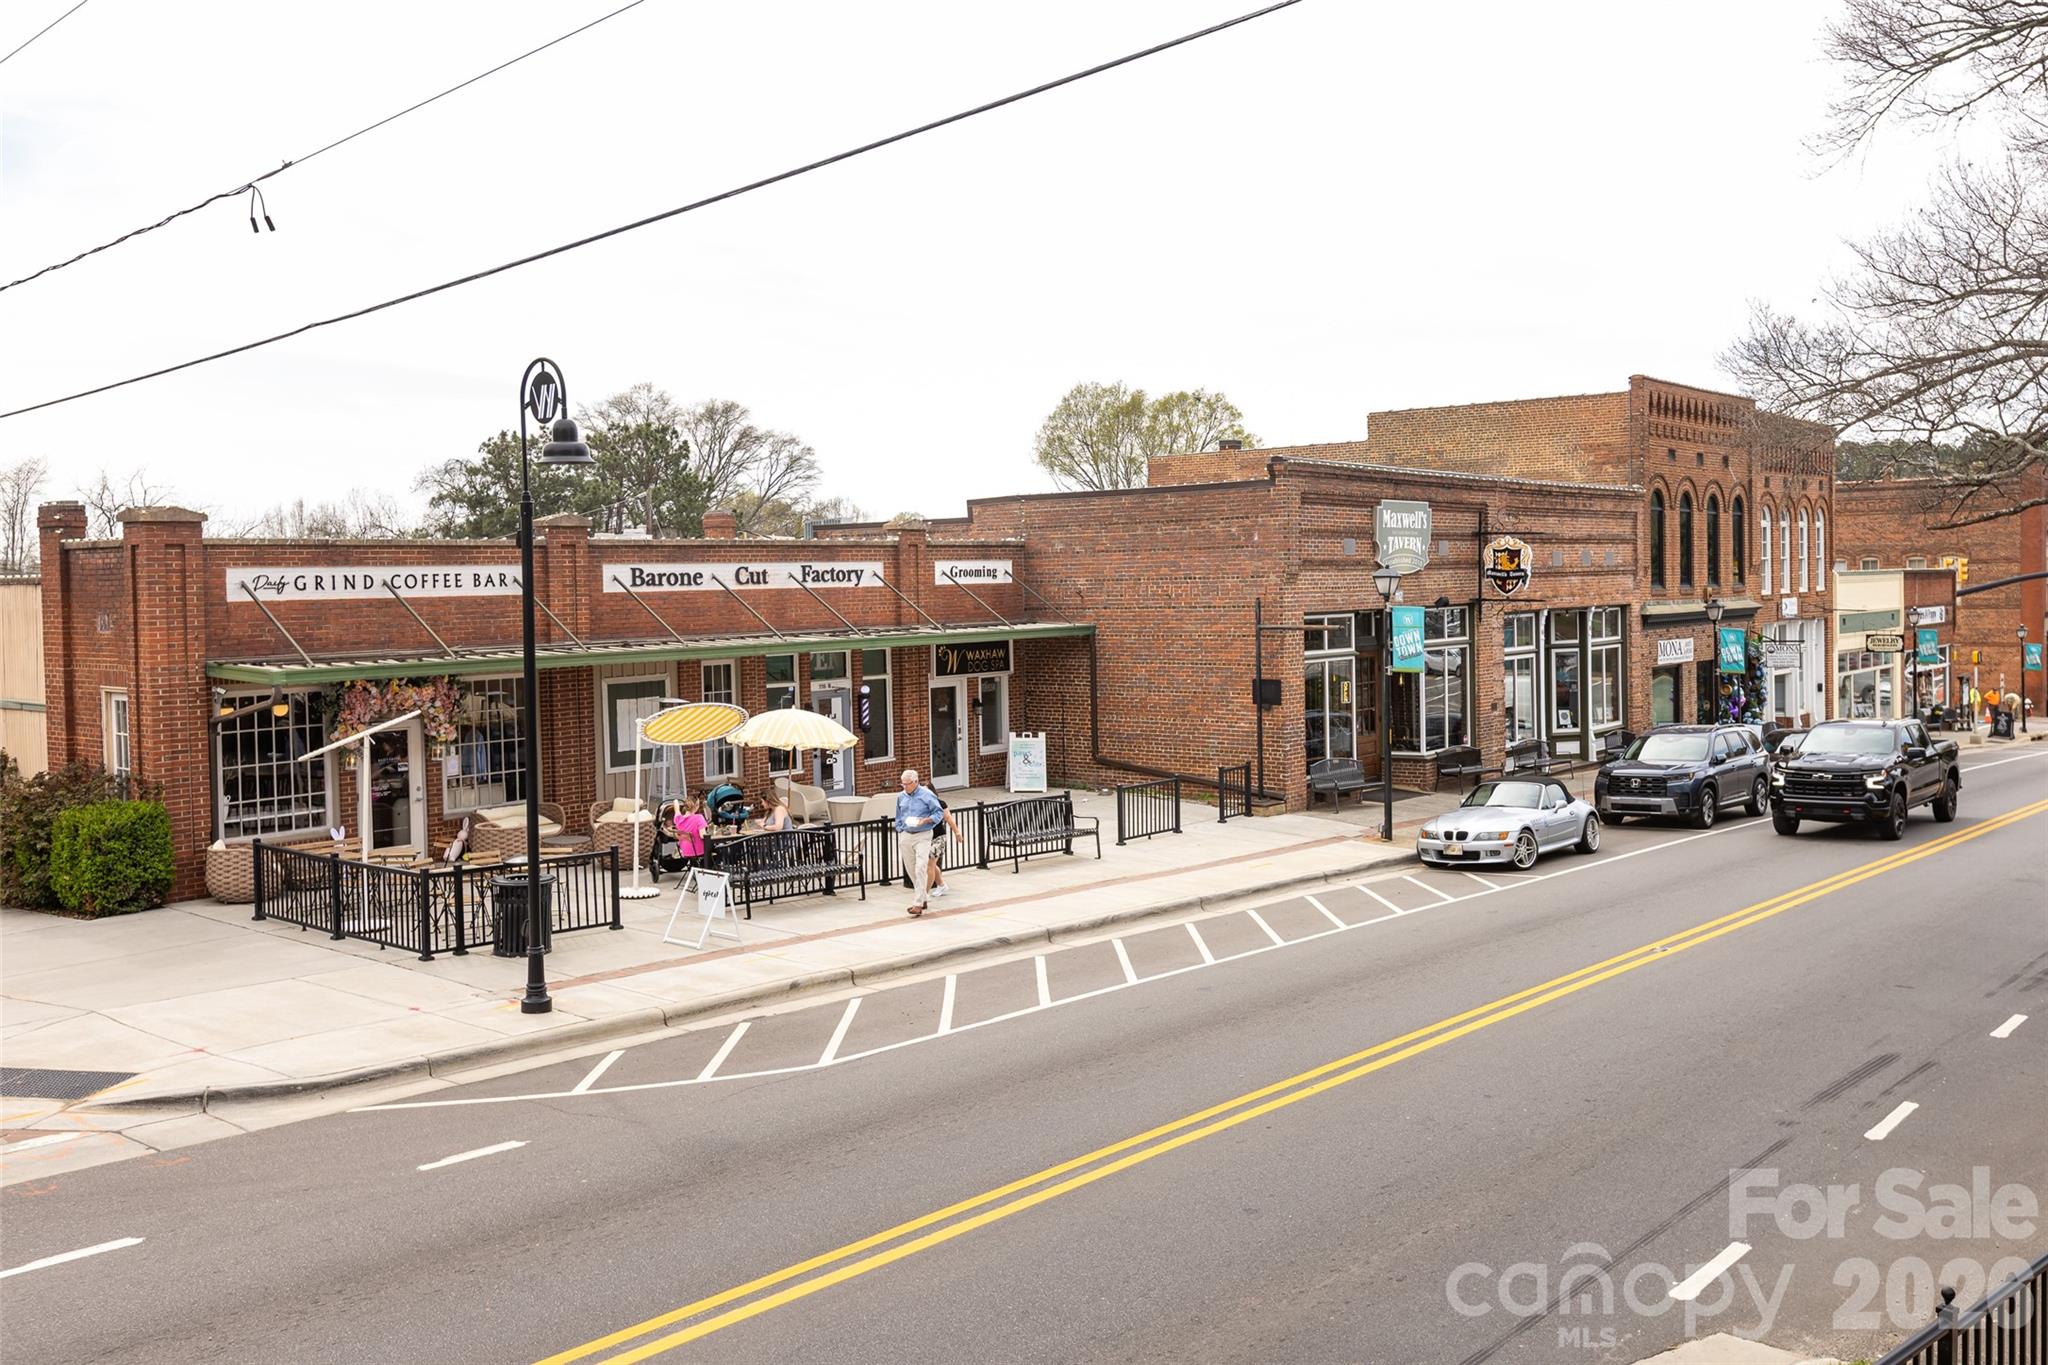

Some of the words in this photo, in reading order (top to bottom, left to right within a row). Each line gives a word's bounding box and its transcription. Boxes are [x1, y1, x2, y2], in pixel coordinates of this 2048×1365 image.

[1382, 509, 1428, 529] Maxwell's
[1387, 536, 1423, 555] TAVERN
[629, 567, 704, 587] Barone
[734, 566, 769, 585] Cut
[800, 564, 864, 588] Factory
[949, 564, 998, 580] Grooming
[252, 574, 290, 594] Daily
[294, 574, 375, 591] GRIND
[390, 573, 463, 590] COFFEE
[473, 572, 509, 588] BAR
[1393, 628, 1420, 647] DOWN
[965, 649, 1006, 660] WAXHAW
[1396, 640, 1423, 657] TOWN
[1659, 640, 1683, 657] MONA
[967, 660, 989, 672] DOG
[991, 659, 1004, 671] SPA
